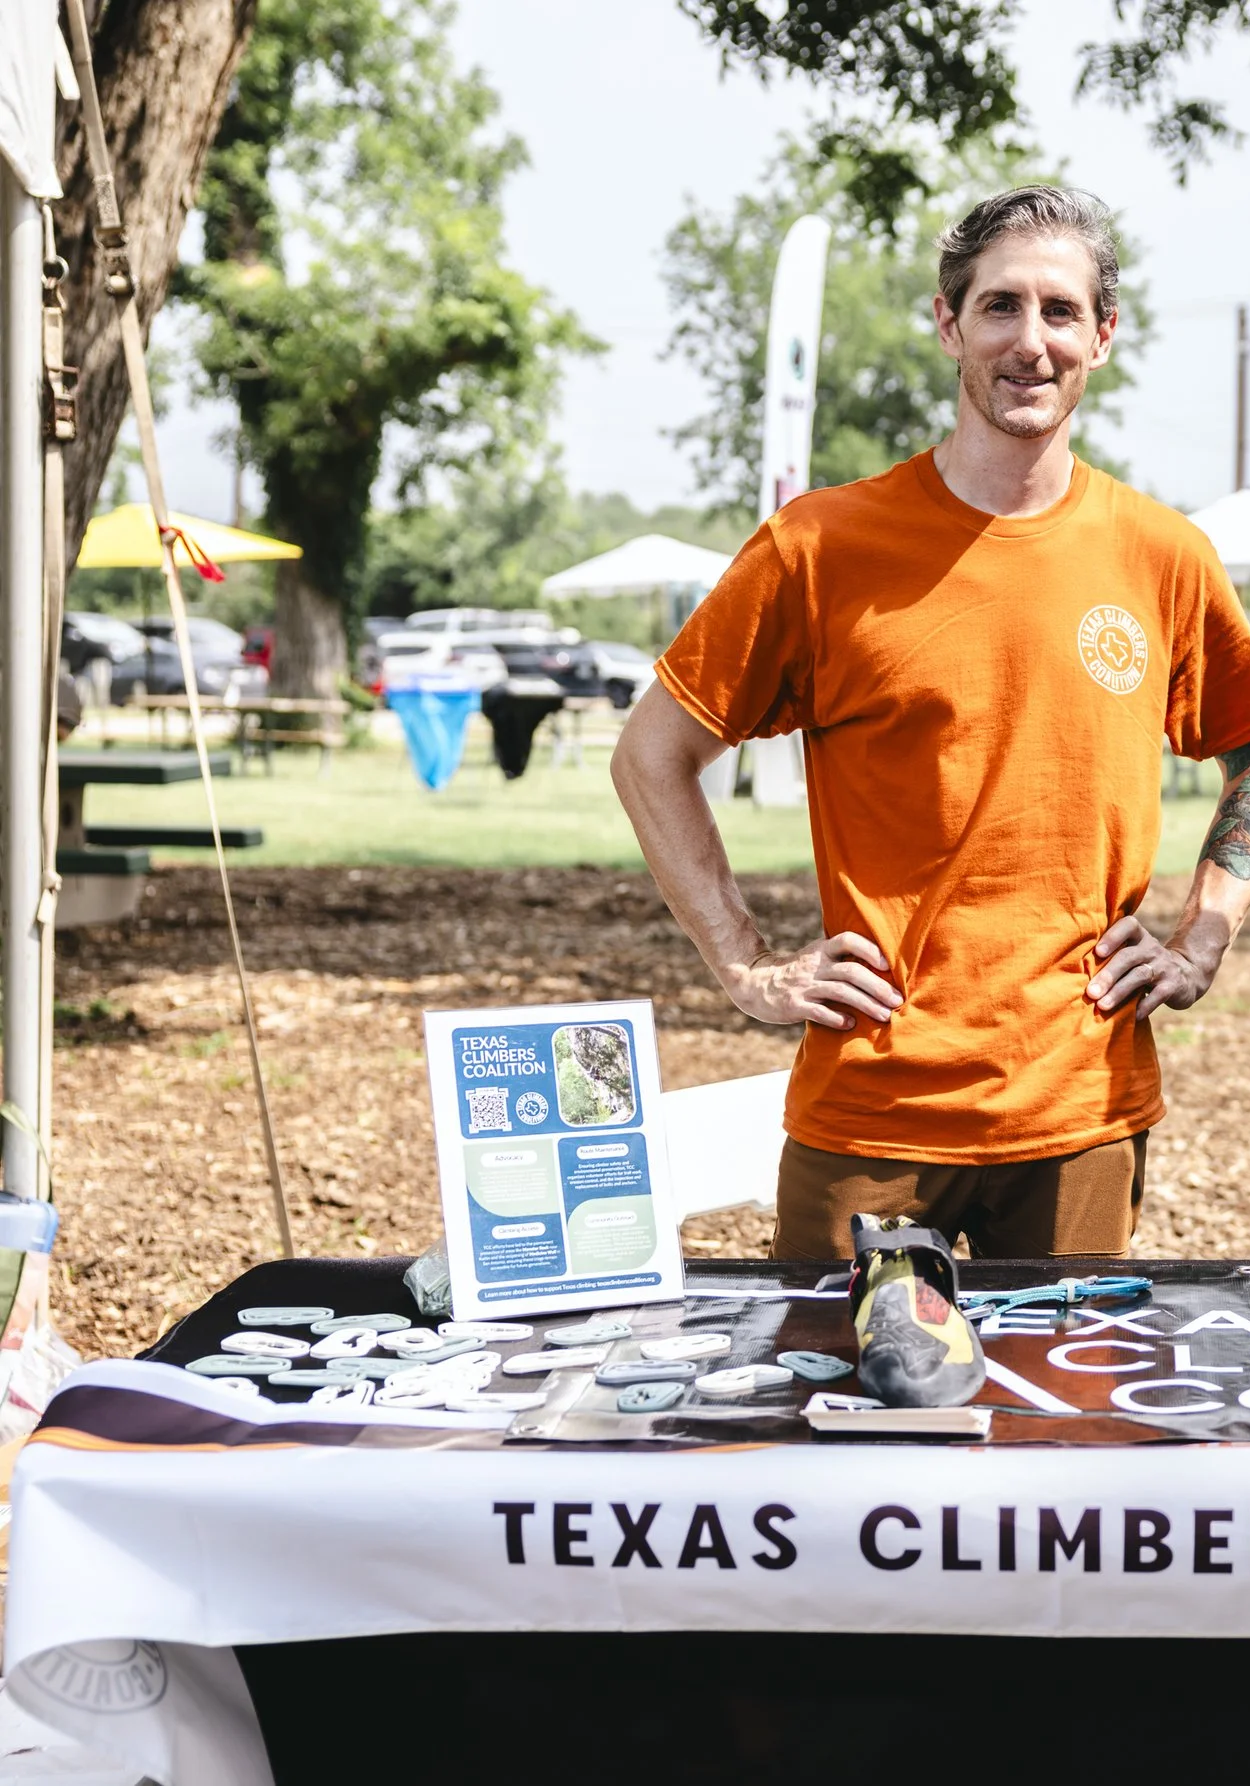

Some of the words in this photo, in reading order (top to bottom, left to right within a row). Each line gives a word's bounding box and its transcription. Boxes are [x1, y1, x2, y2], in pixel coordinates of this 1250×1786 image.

[1082, 611, 1105, 648] TEXAS
[1104, 609, 1145, 659] CLIMBERS
[1089, 659, 1141, 690] COALITION
[460, 1036, 508, 1050] TEXAS
[461, 1048, 536, 1064] CLIMBERS
[463, 1061, 546, 1079] COALITION
[493, 1501, 799, 1570] TEXAS
